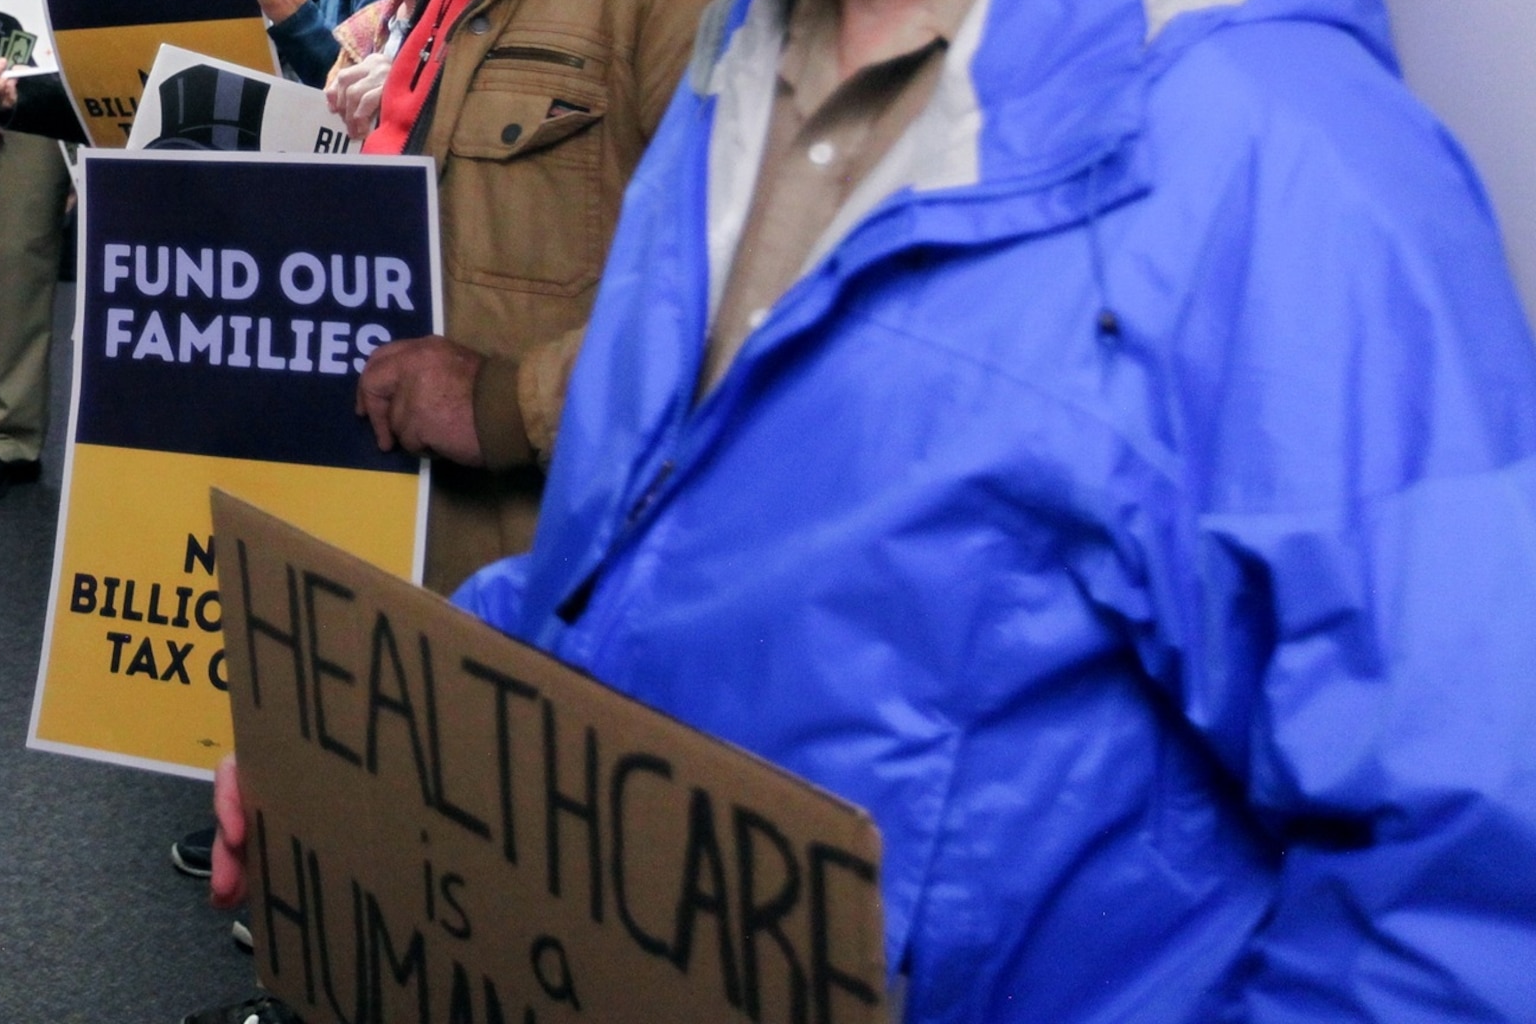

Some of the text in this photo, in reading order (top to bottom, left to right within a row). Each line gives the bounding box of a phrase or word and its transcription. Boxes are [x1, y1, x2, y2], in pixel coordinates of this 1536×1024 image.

[103, 243, 415, 310] FUND OUR
[104, 309, 392, 376] FAMILIES
[70, 572, 223, 633] BILLIO
[107, 632, 194, 685] TAX
[236, 538, 880, 1024] HEALTHCARE
[420, 829, 472, 941] is
[530, 933, 582, 1012] a
